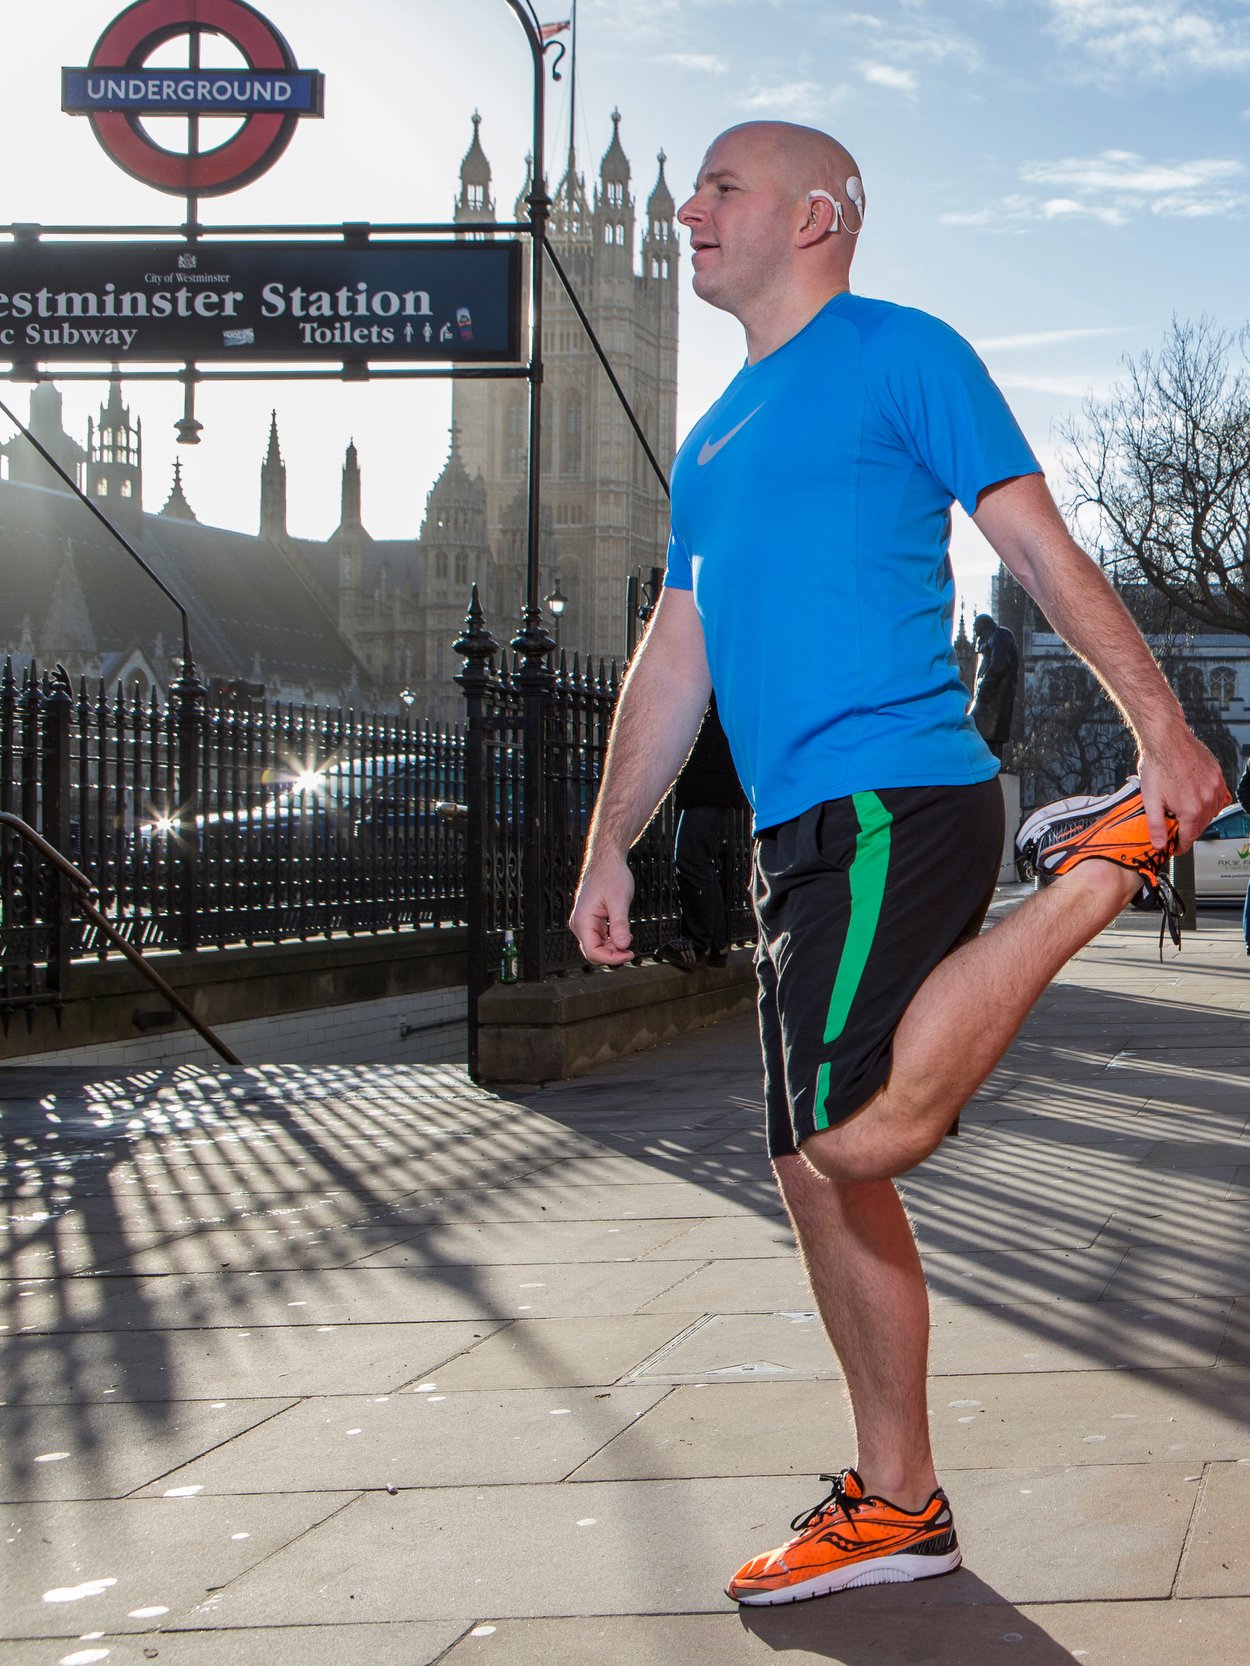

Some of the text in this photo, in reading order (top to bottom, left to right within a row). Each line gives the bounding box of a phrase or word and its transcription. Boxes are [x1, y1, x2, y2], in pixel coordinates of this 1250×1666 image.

[87, 79, 292, 101] UNDERGROUND
[144, 272, 230, 286] City of Westminster
[261, 282, 434, 318] Station
[25, 322, 138, 350] Subway
[299, 321, 395, 344] Toilets
